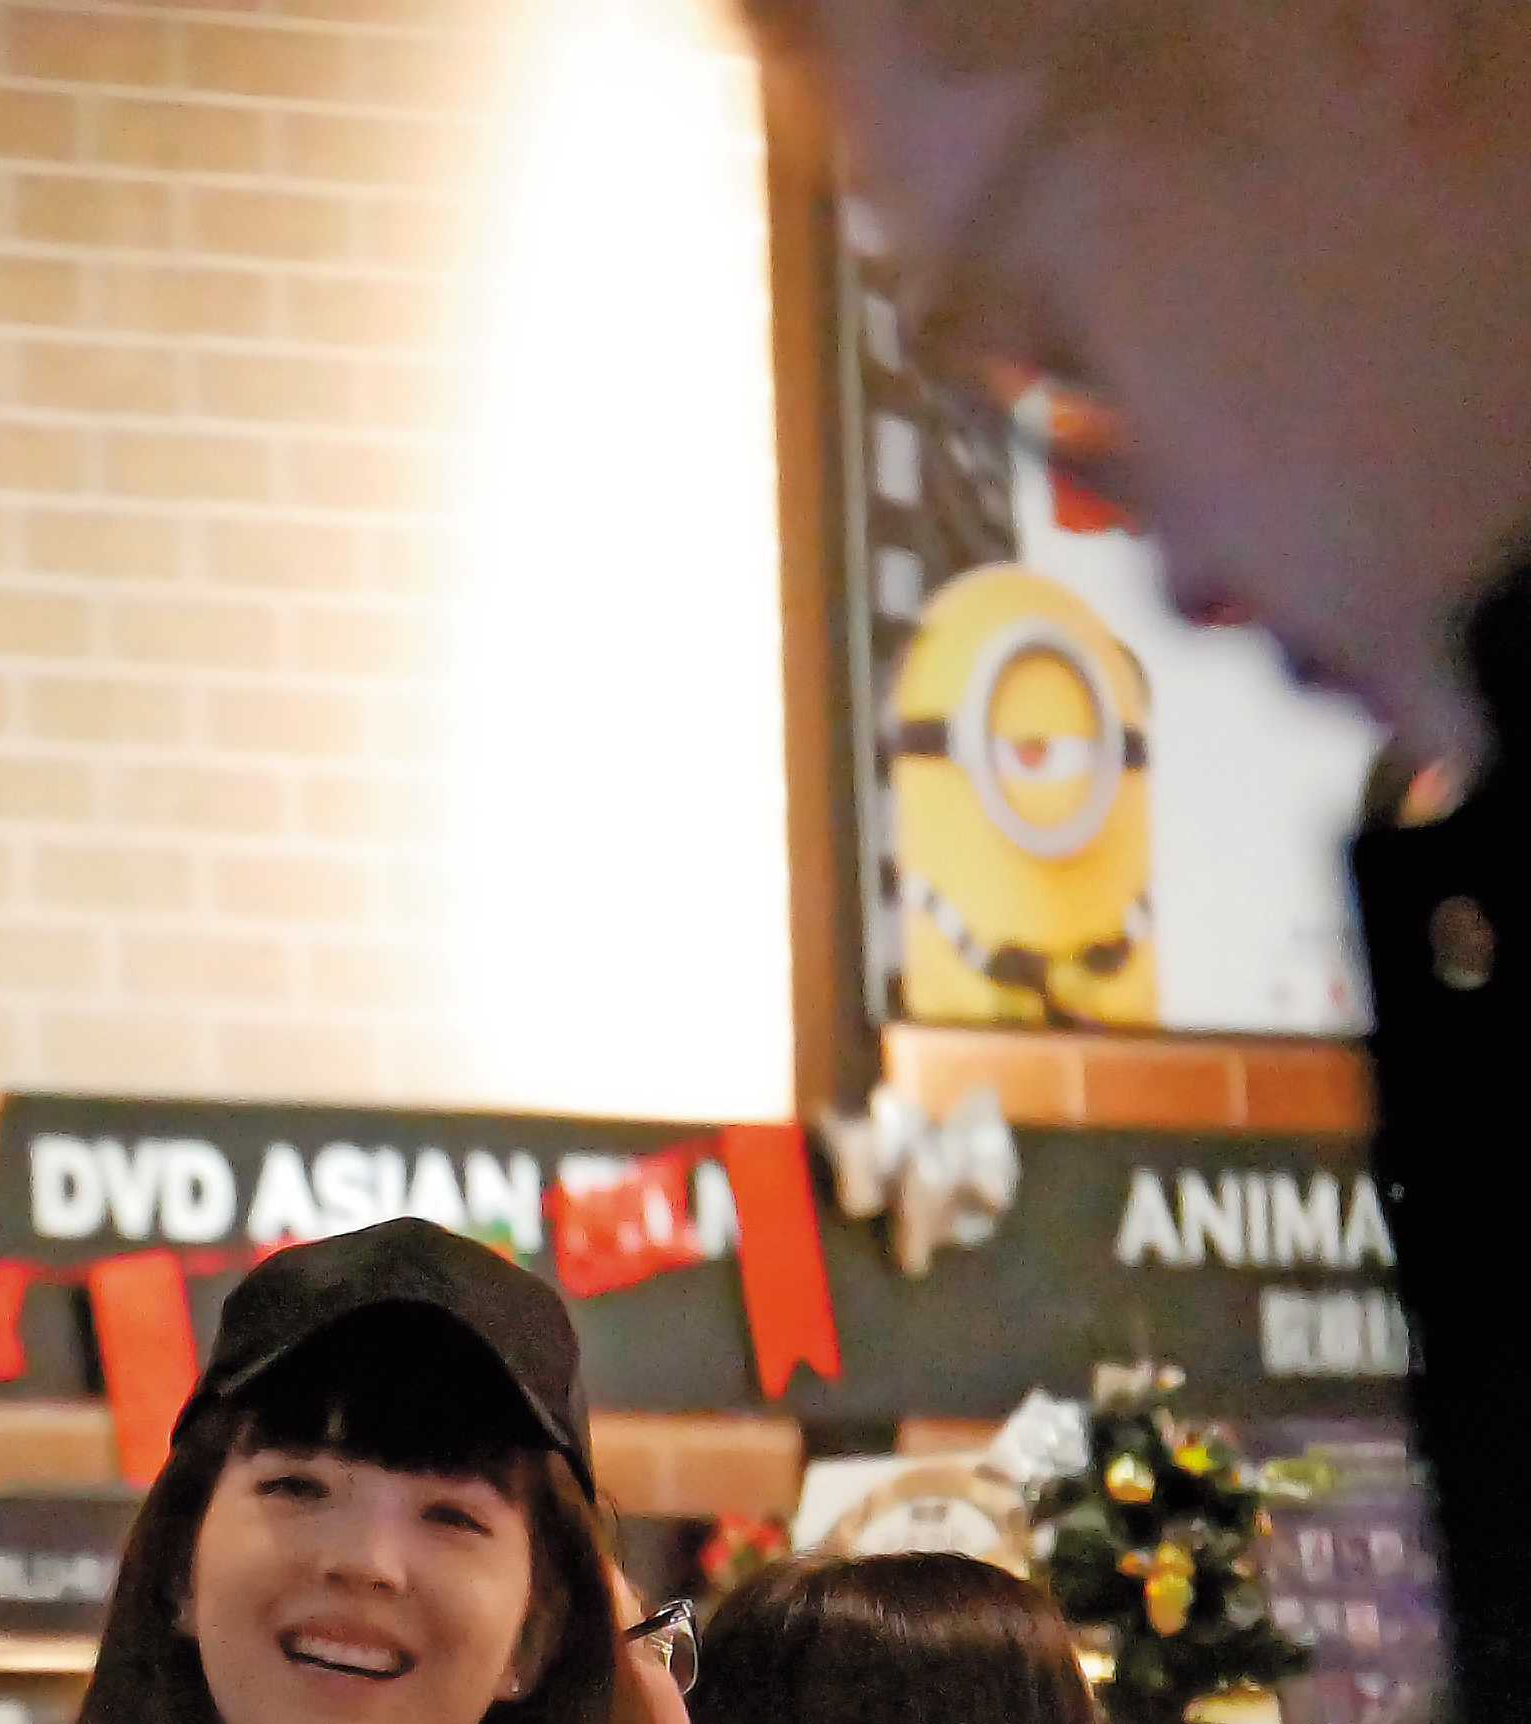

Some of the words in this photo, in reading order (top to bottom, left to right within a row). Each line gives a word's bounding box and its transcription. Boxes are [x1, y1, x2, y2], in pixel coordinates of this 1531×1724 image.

[30, 1133, 236, 1242] DVD
[245, 1140, 541, 1254] ASIAN
[1115, 1167, 1399, 1268] ANIMA
